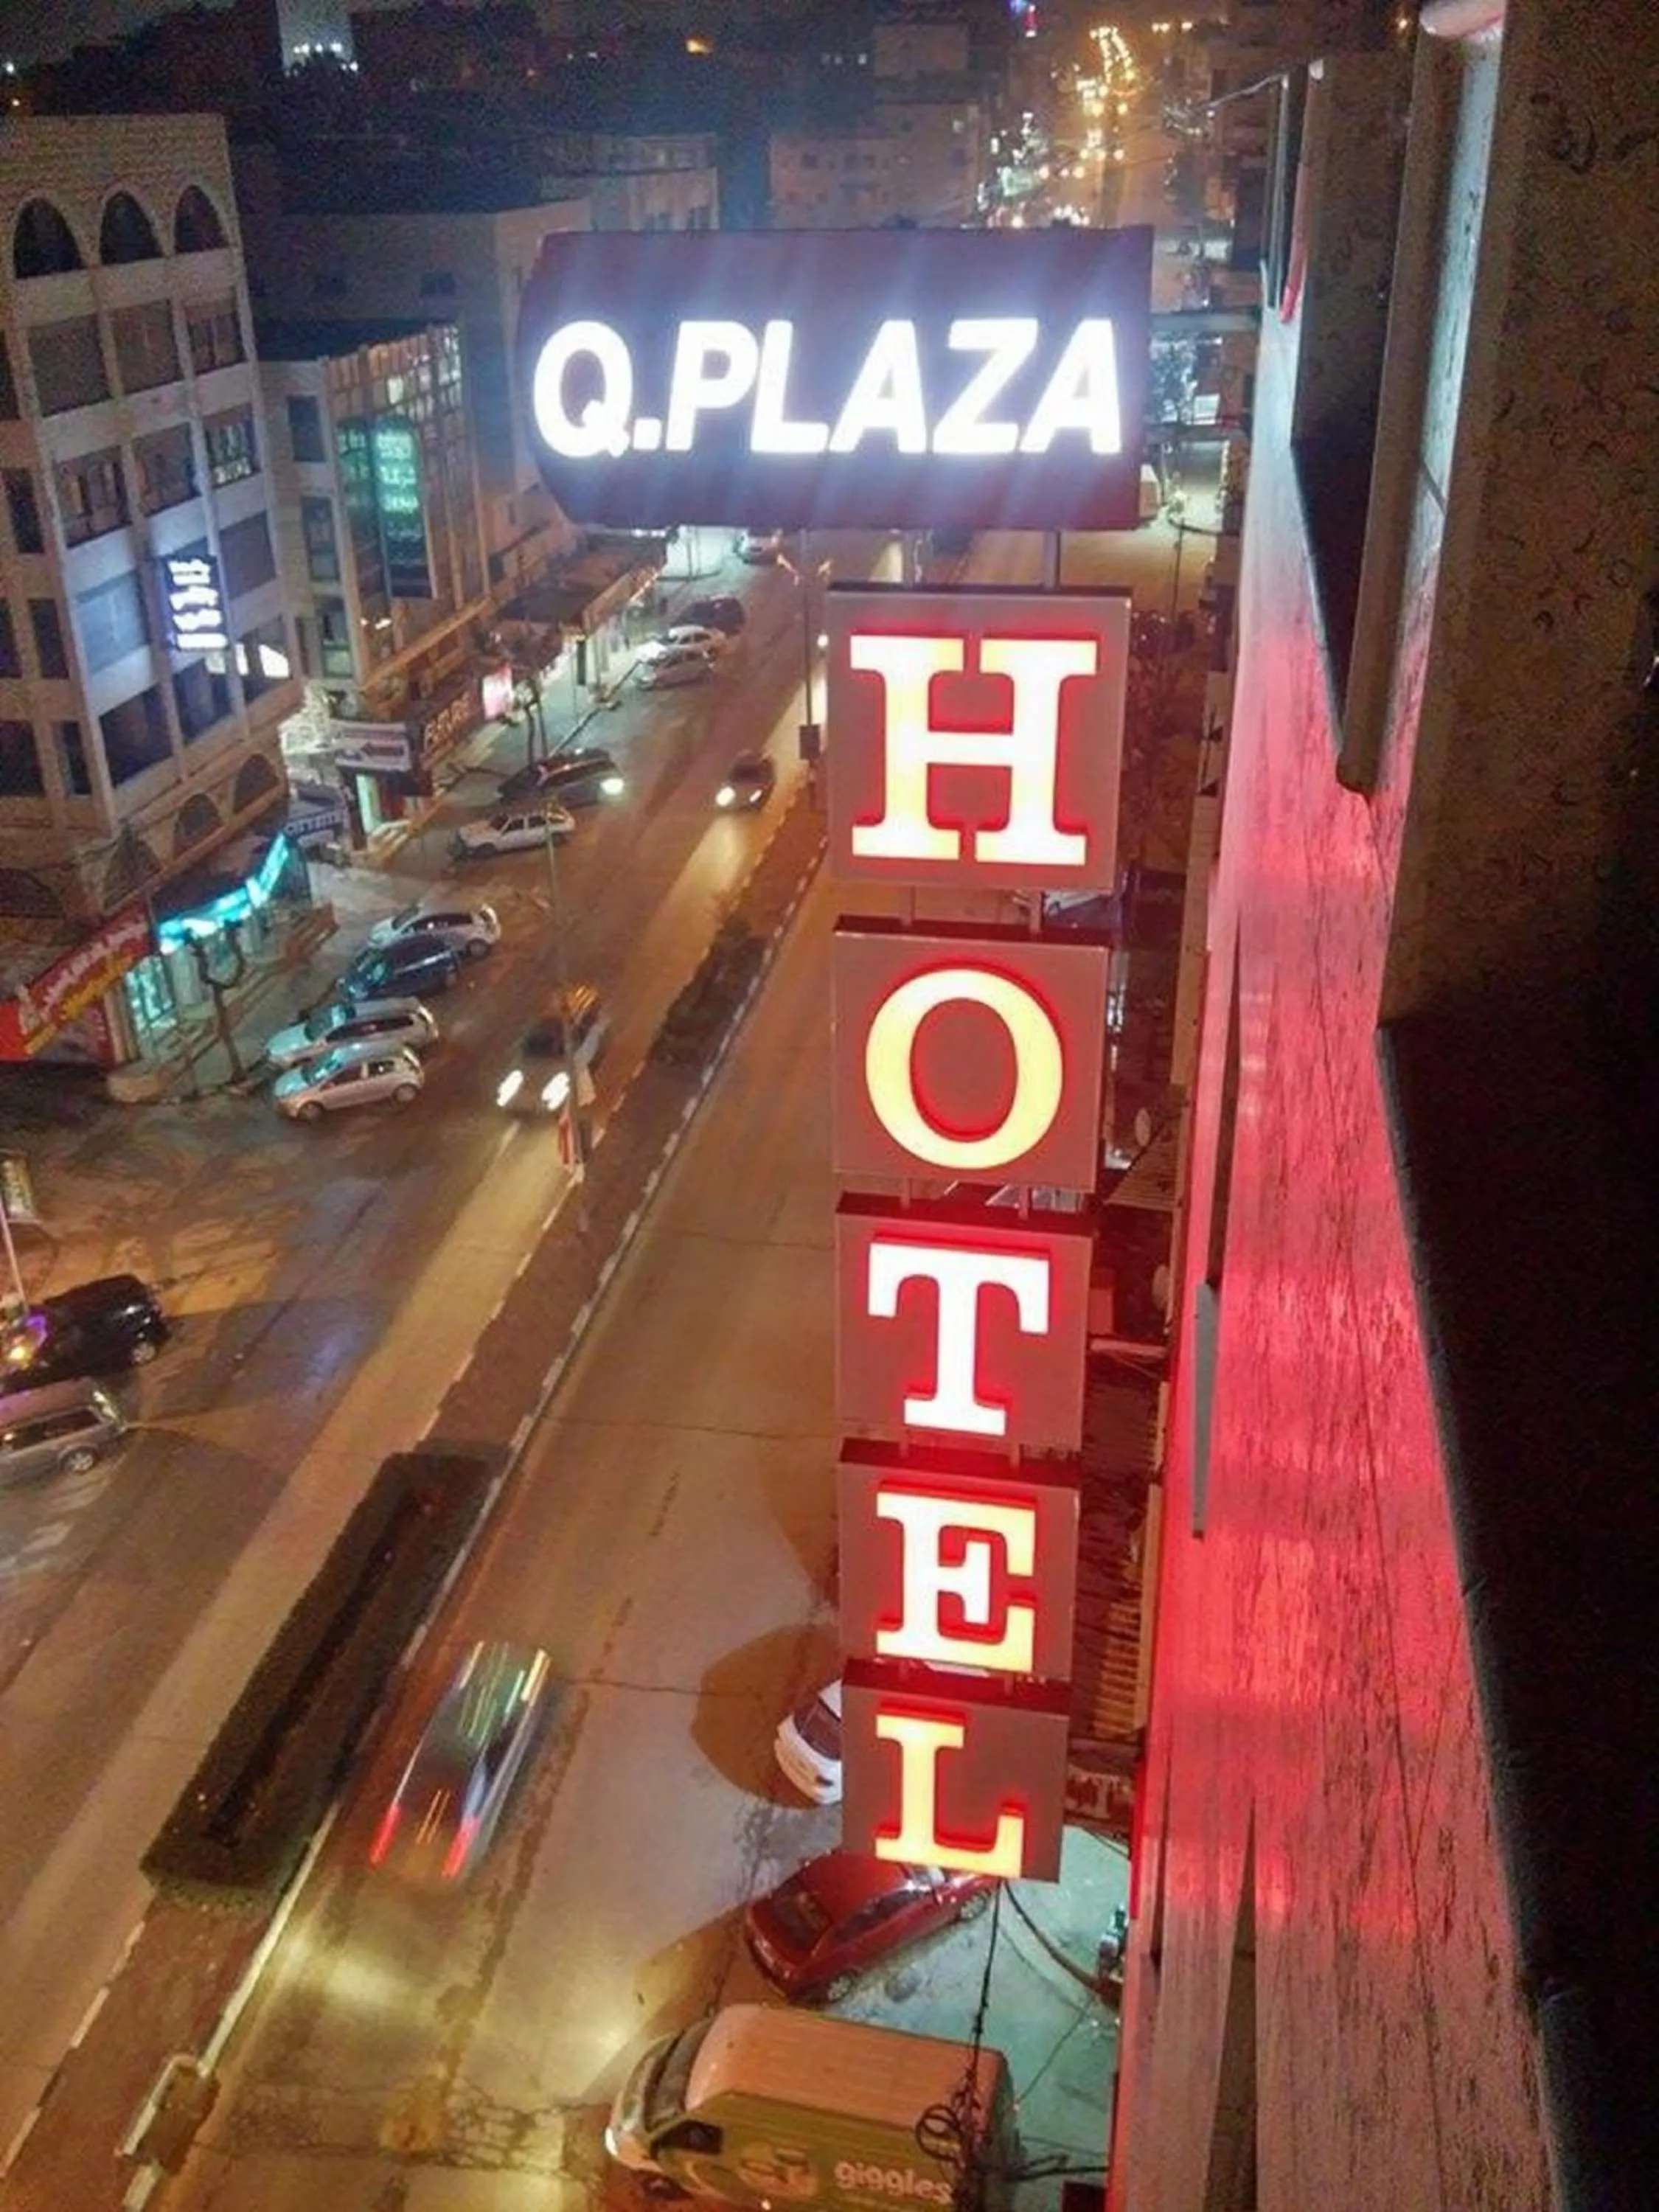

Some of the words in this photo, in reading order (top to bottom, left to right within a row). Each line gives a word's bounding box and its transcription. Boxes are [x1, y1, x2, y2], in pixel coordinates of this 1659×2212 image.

[534, 319, 1122, 457] Q.PLAZA
[849, 635, 1099, 1879] HOTEL
[835, 2161, 953, 2204] giggles
